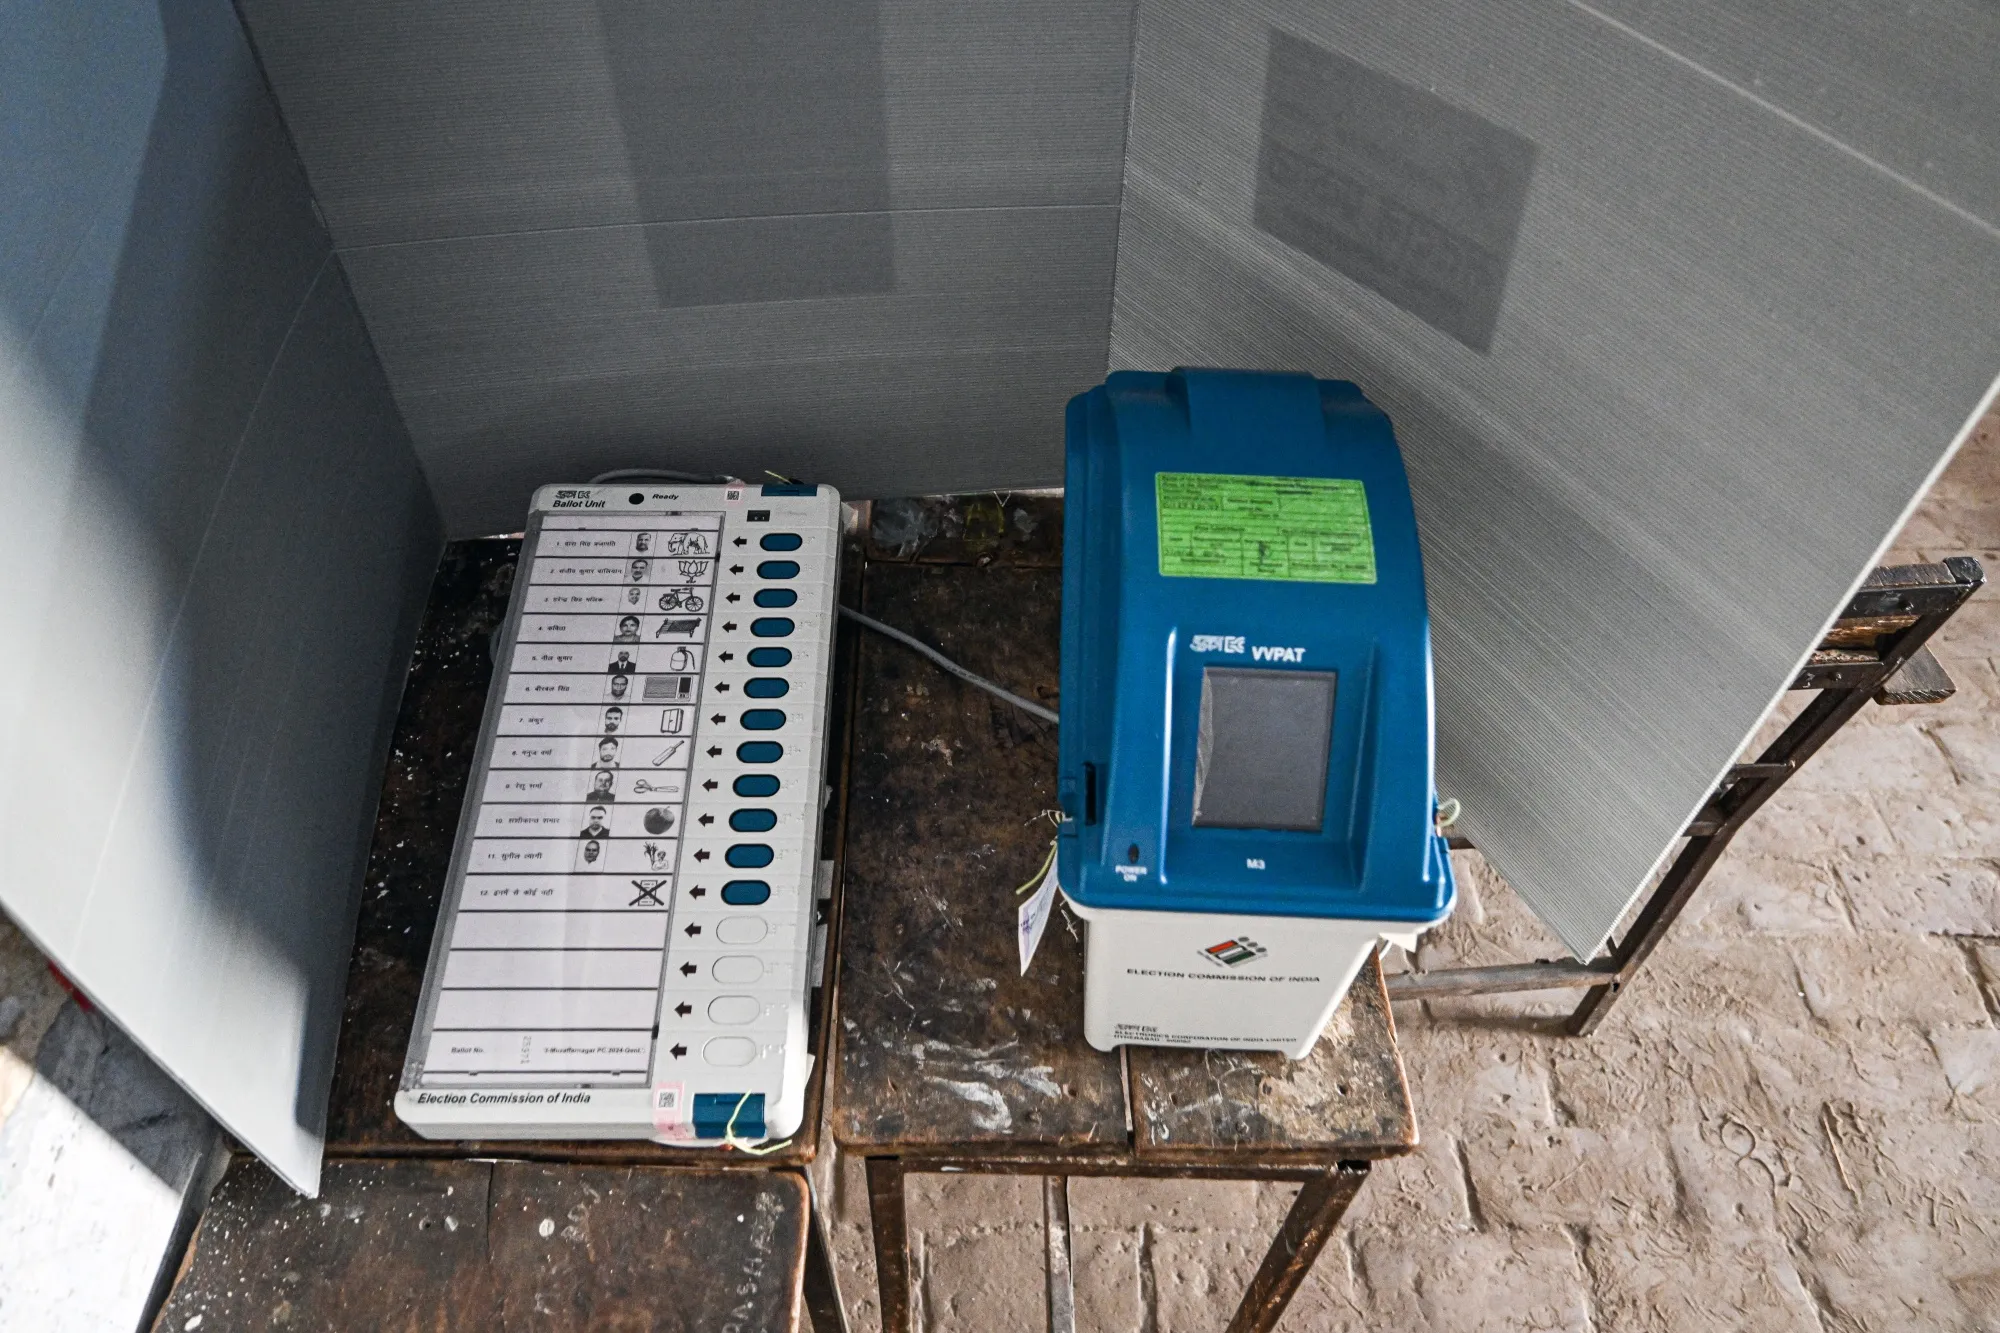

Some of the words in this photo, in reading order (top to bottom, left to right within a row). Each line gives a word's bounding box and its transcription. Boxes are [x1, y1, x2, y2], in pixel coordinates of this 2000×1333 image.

[1251, 646, 1306, 663] VVPAT
[1115, 865, 1147, 875] POWER
[1246, 858, 1265, 870] M3
[1123, 874, 1137, 882] ON
[1126, 968, 1185, 978] ELECTION
[1188, 973, 1266, 982] COMMISSION
[417, 1092, 466, 1104] Election
[470, 1093, 544, 1104] Commission
[547, 1092, 559, 1104] of
[561, 1092, 591, 1104] India
